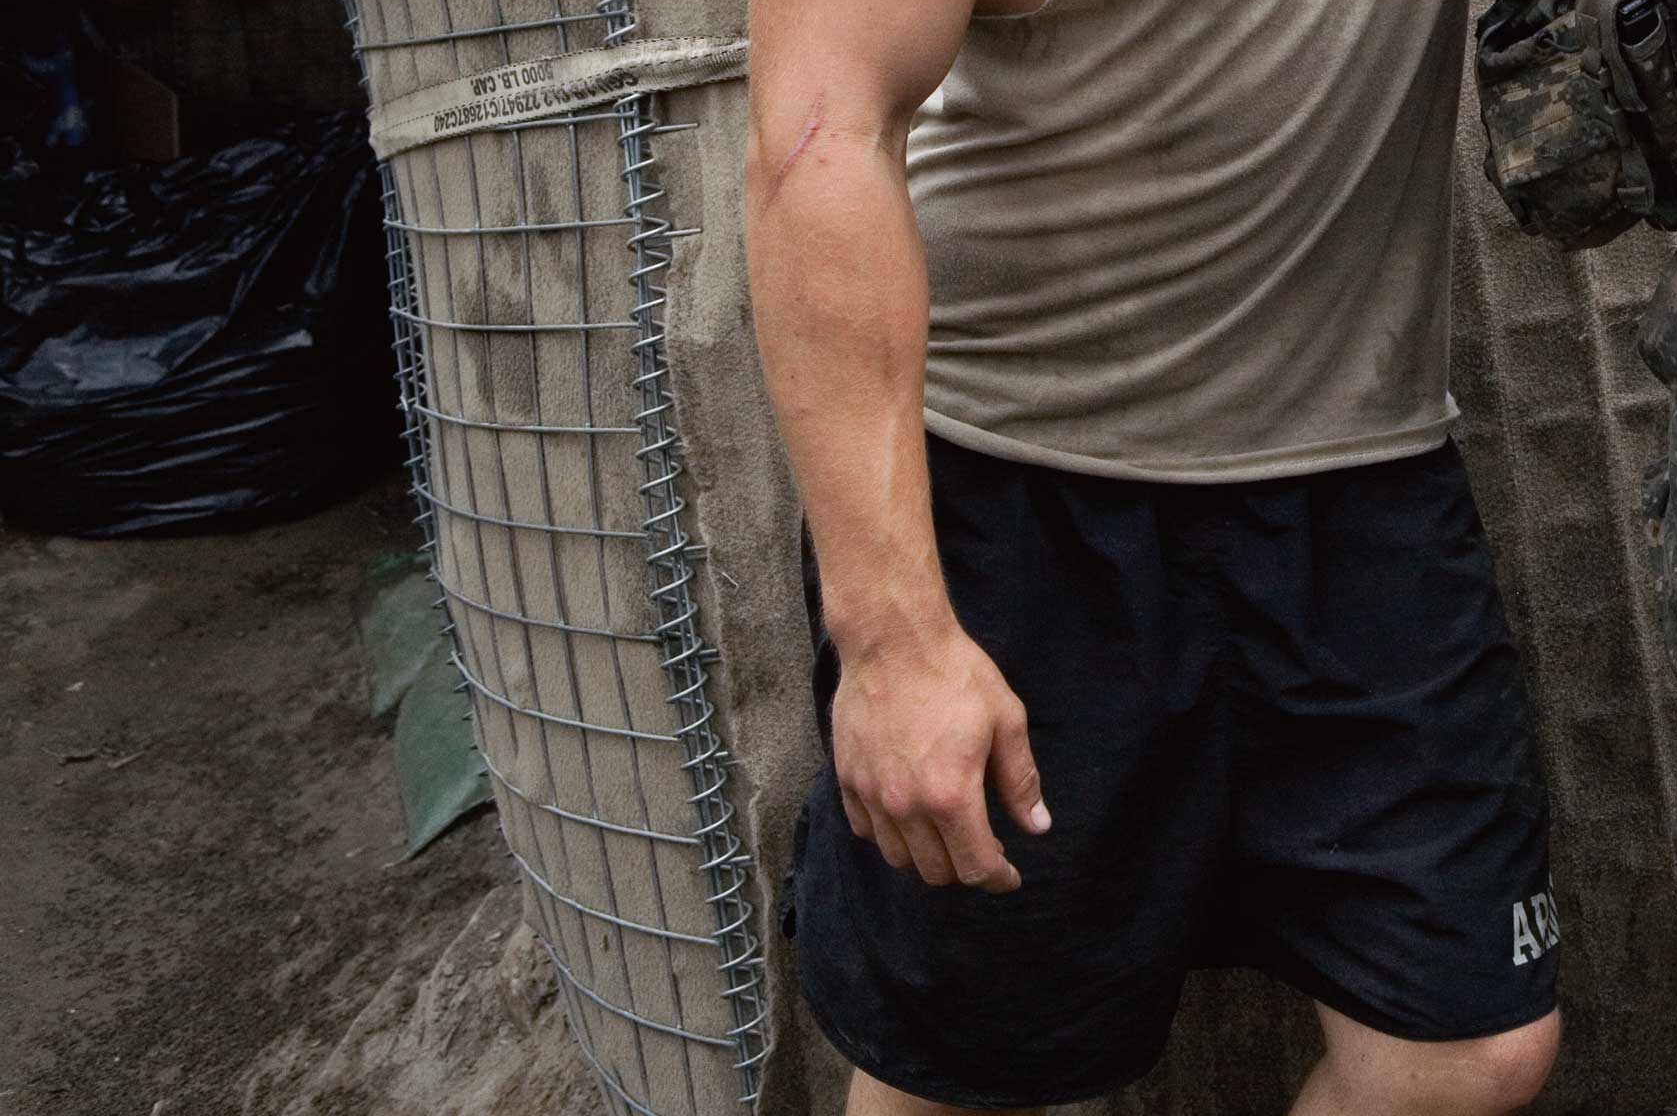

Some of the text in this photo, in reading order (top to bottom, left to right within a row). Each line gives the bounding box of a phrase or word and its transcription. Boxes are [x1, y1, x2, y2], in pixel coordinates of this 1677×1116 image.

[469, 63, 554, 96] 5000 LB. CAP.
